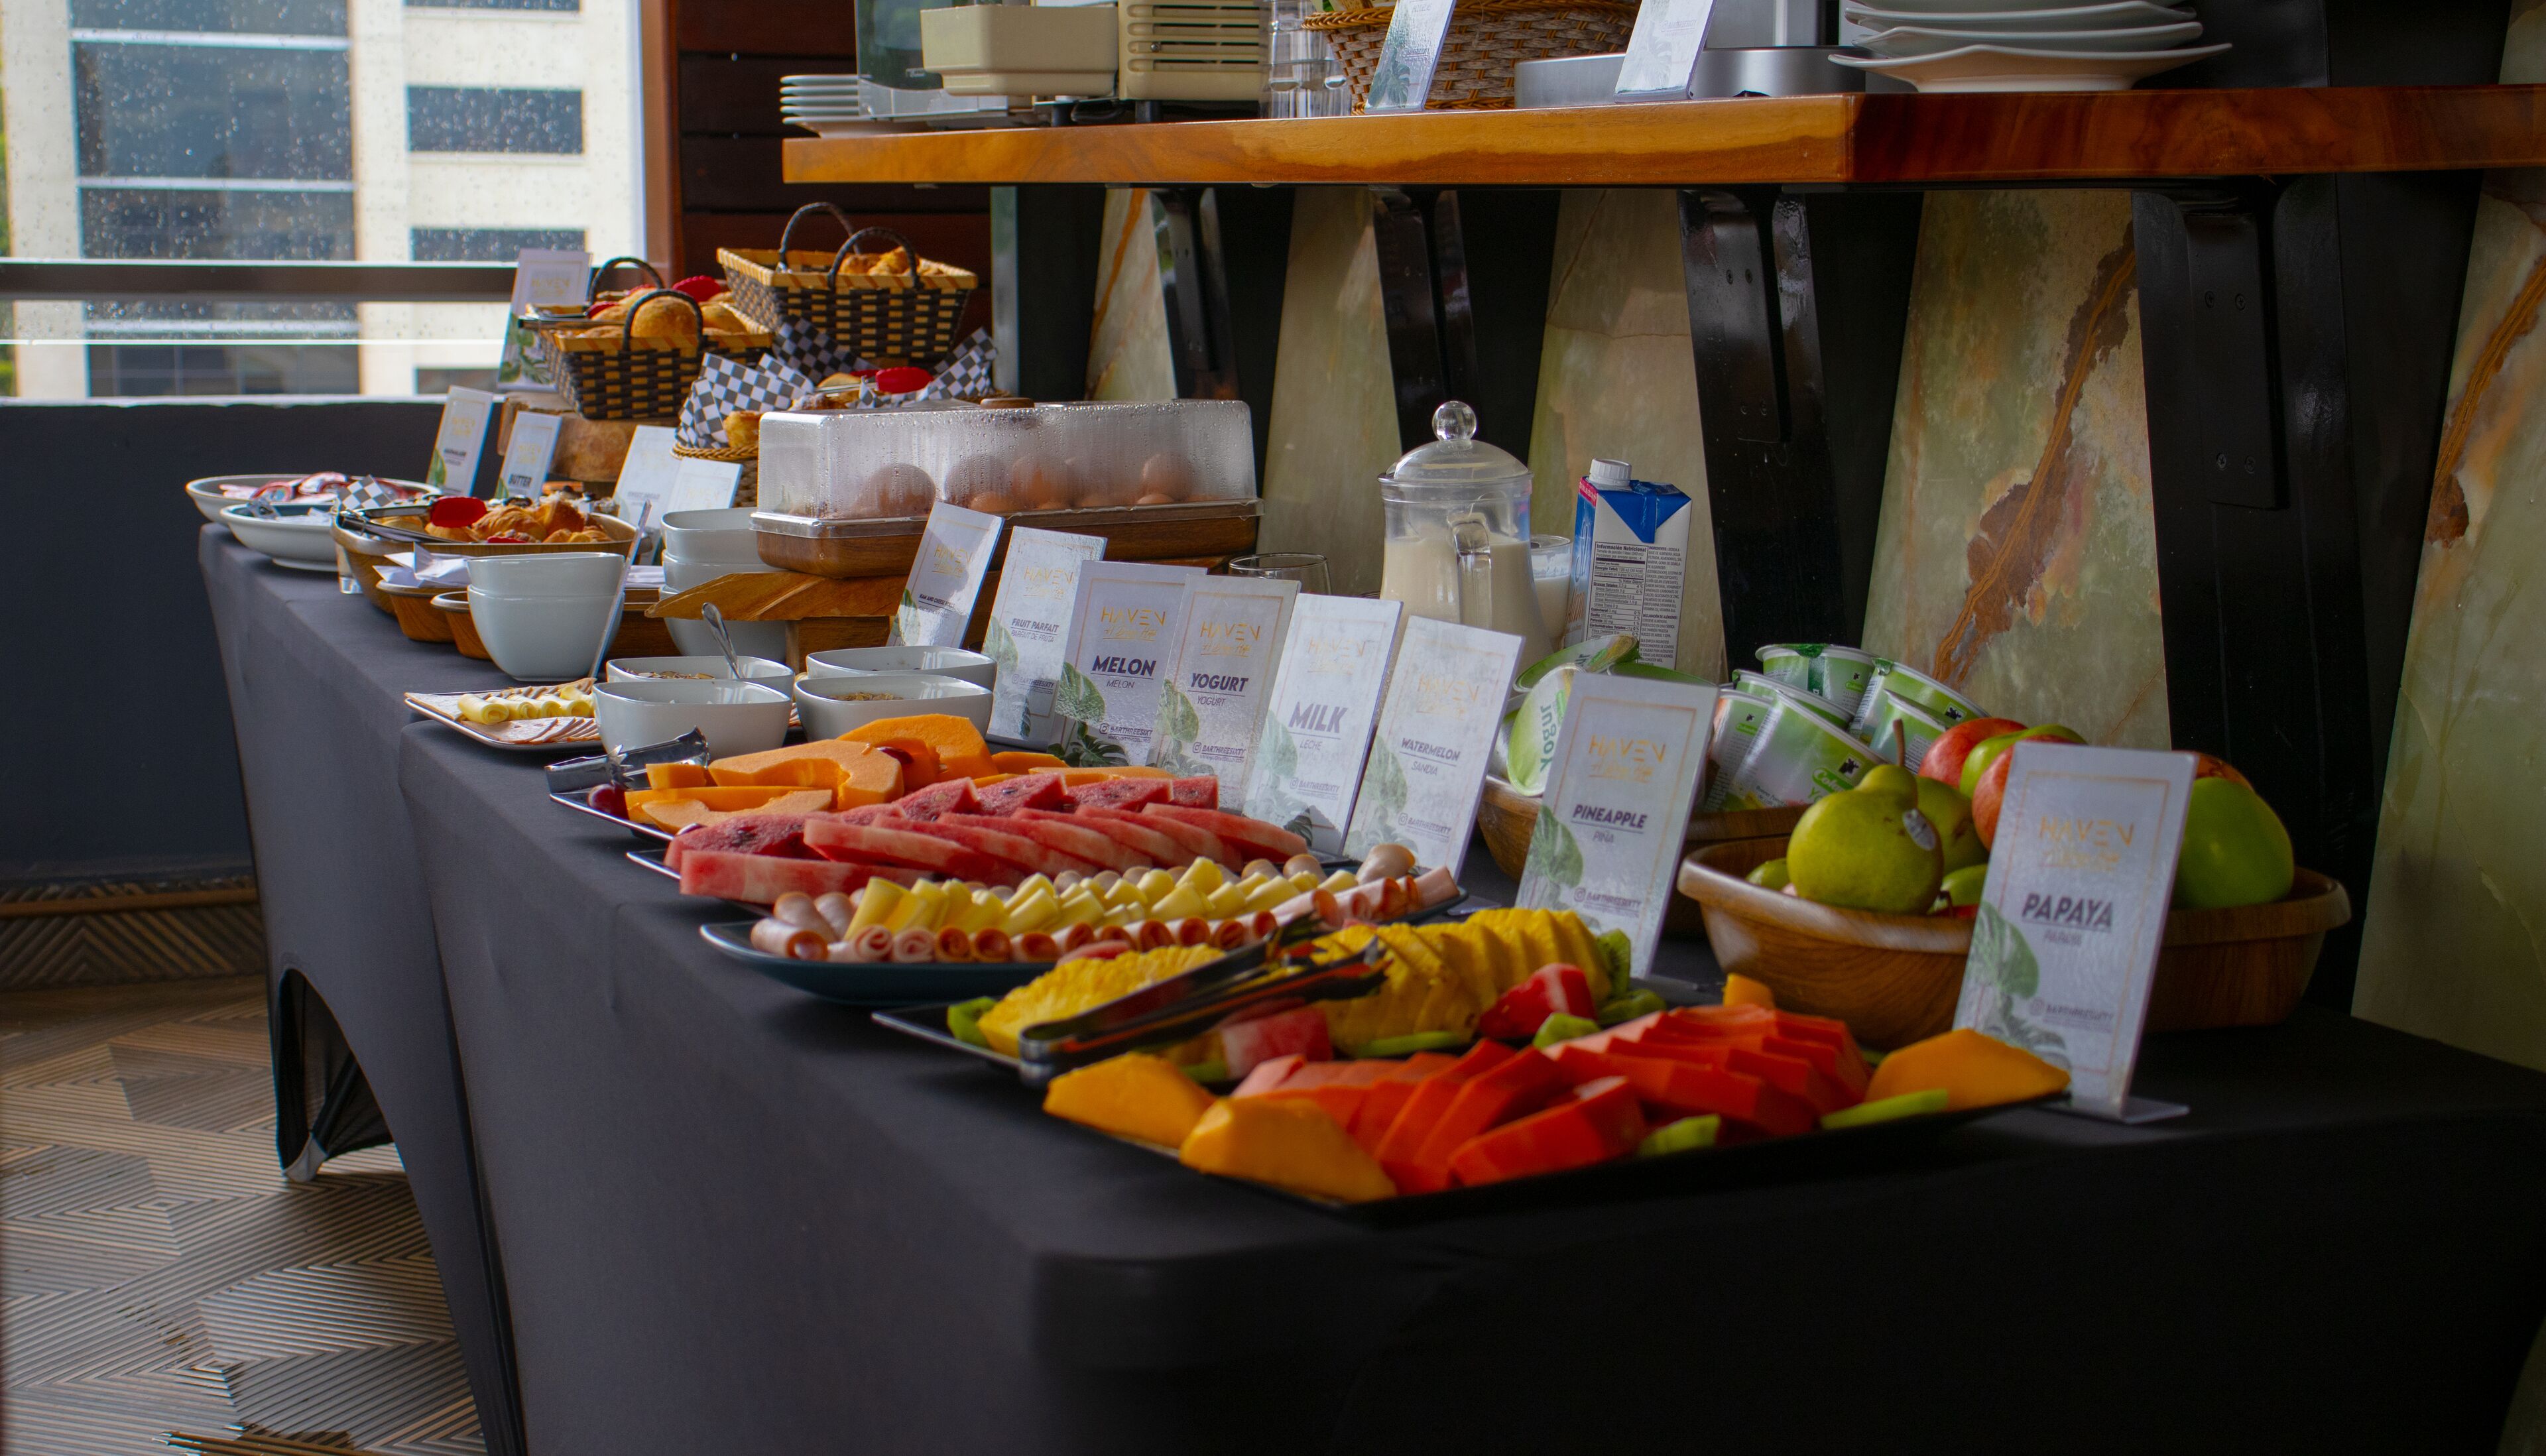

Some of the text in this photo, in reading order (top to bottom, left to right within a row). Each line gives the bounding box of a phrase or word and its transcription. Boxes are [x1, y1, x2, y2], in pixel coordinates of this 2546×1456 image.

[509, 473, 532, 487] BUTTER
[1024, 566, 1073, 585] HAVEN
[1011, 617, 1060, 633] FRUIT PARFAIT
[1101, 606, 1166, 627] HAVEN
[1011, 630, 1030, 640] PARFAIT
[1038, 633, 1054, 642] FRUTA
[1200, 621, 1260, 641] HAVEN
[1307, 635, 1366, 658] HAVEN
[1092, 655, 1157, 676] MELON
[1106, 679, 1135, 689] MELON
[1191, 672, 1249, 692] YOGURT
[1418, 672, 1480, 701] HAVEN
[1197, 696, 1227, 707] YOGURT
[1288, 701, 1349, 733] MILK
[1111, 726, 1153, 737] BARTHREESIXT
[1540, 703, 1557, 772] Yogur
[1201, 745, 1246, 756] BARTHREESIXTY
[1300, 739, 1323, 751] LECHE
[1401, 738, 1461, 761] WATERMELON
[1589, 735, 1666, 763] HAVEN
[1411, 760, 1439, 776] SANDIA
[1299, 780, 1340, 792] BARTHREESIXTY
[1408, 818, 1452, 834] BARTHREESIXTY
[1573, 804, 1648, 829] PINEAPPLE
[1593, 830, 1614, 843] PIÑA
[2039, 816, 2134, 848] HAVEN
[2022, 892, 2112, 928] PAPAYA
